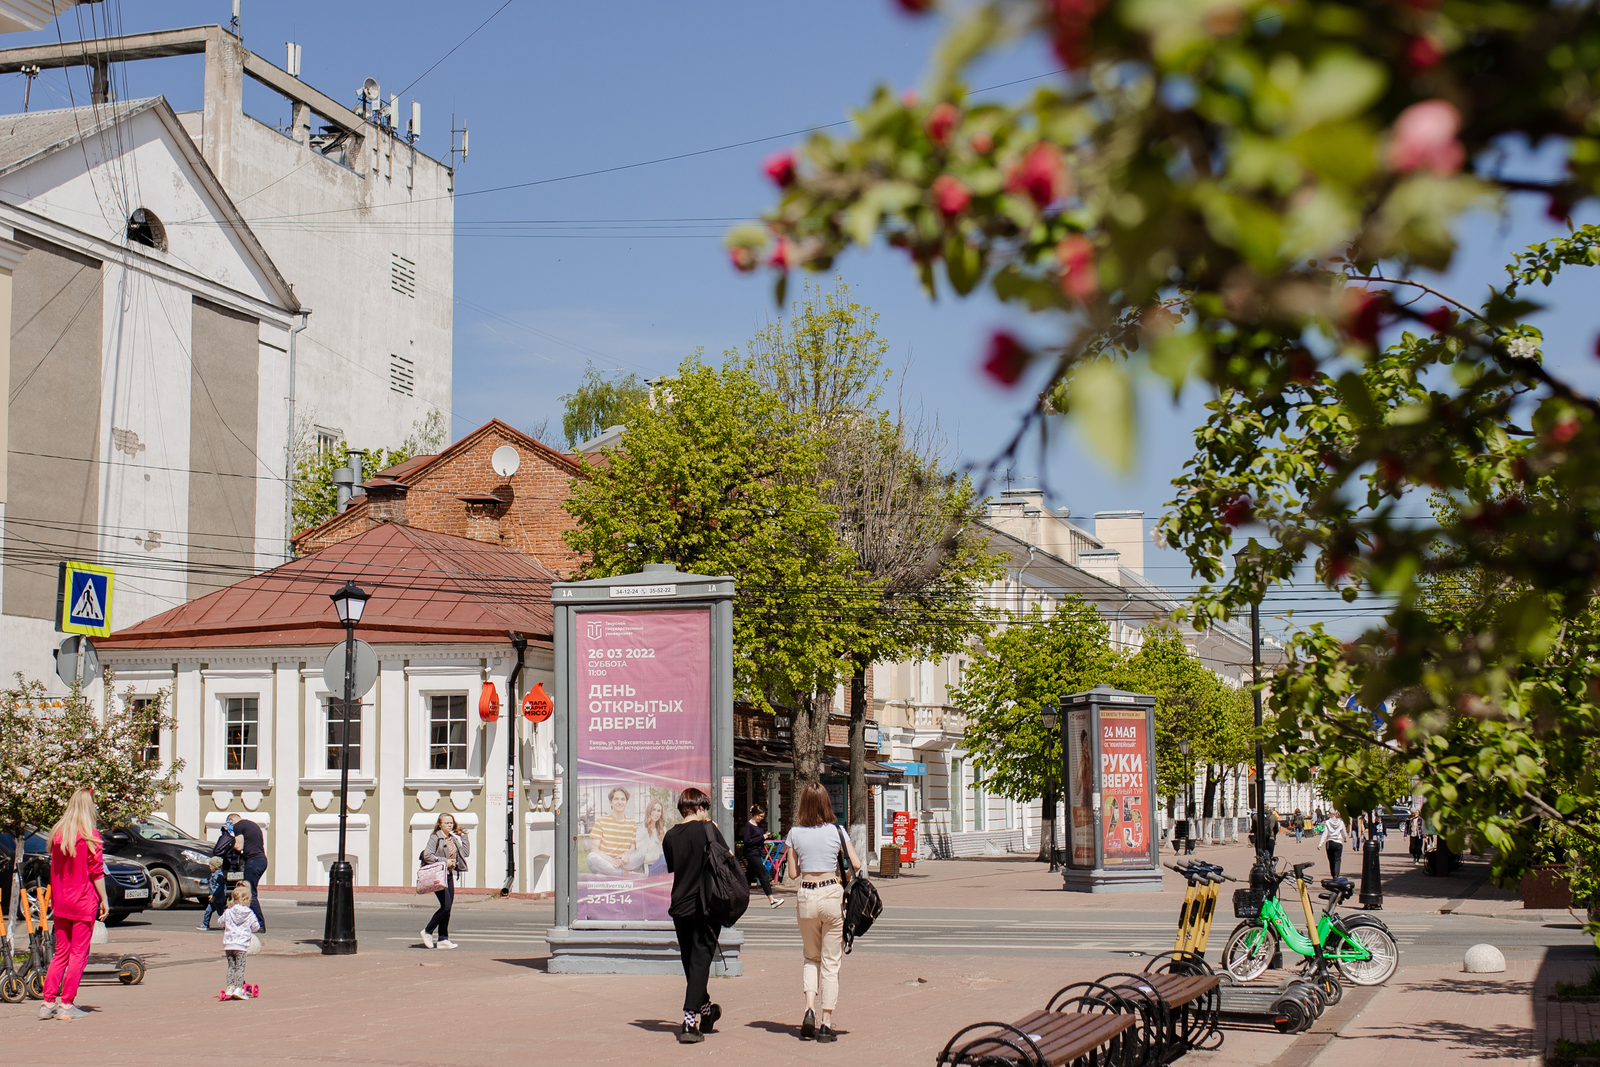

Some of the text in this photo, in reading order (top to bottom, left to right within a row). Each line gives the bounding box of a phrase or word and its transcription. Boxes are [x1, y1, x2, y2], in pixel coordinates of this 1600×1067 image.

[588, 684, 636, 699] ДЕНЬ
[589, 700, 684, 713] ОТКРЫТЫХ
[588, 713, 656, 732] ДВЕРЕЙ
[1104, 726, 1136, 738] 24 МАЯ
[1102, 754, 1142, 772] РУКИ
[587, 894, 632, 904] 32-15-14
